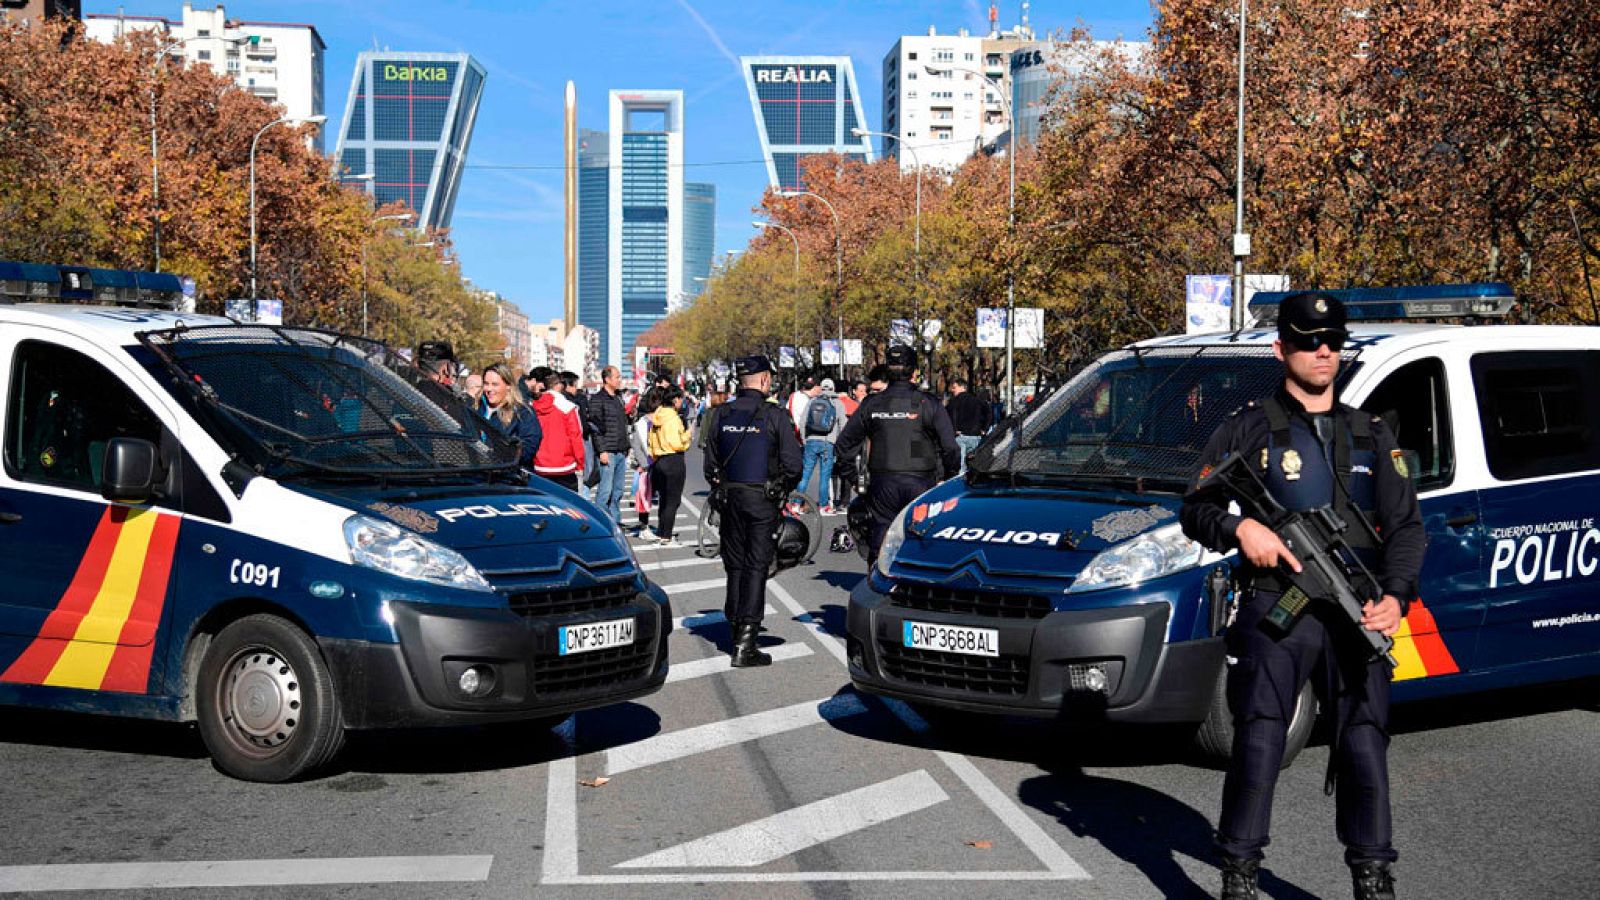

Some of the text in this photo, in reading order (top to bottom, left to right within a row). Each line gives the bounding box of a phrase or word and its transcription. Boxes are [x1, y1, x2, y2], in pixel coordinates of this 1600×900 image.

[384, 65, 447, 81] Bankia
[871, 412, 911, 420] POLICIA
[436, 503, 566, 522] POLICIA
[1494, 518, 1595, 538] CUERPO NACIONAL DE
[1489, 528, 1600, 588] POLIC
[241, 562, 280, 588] 091
